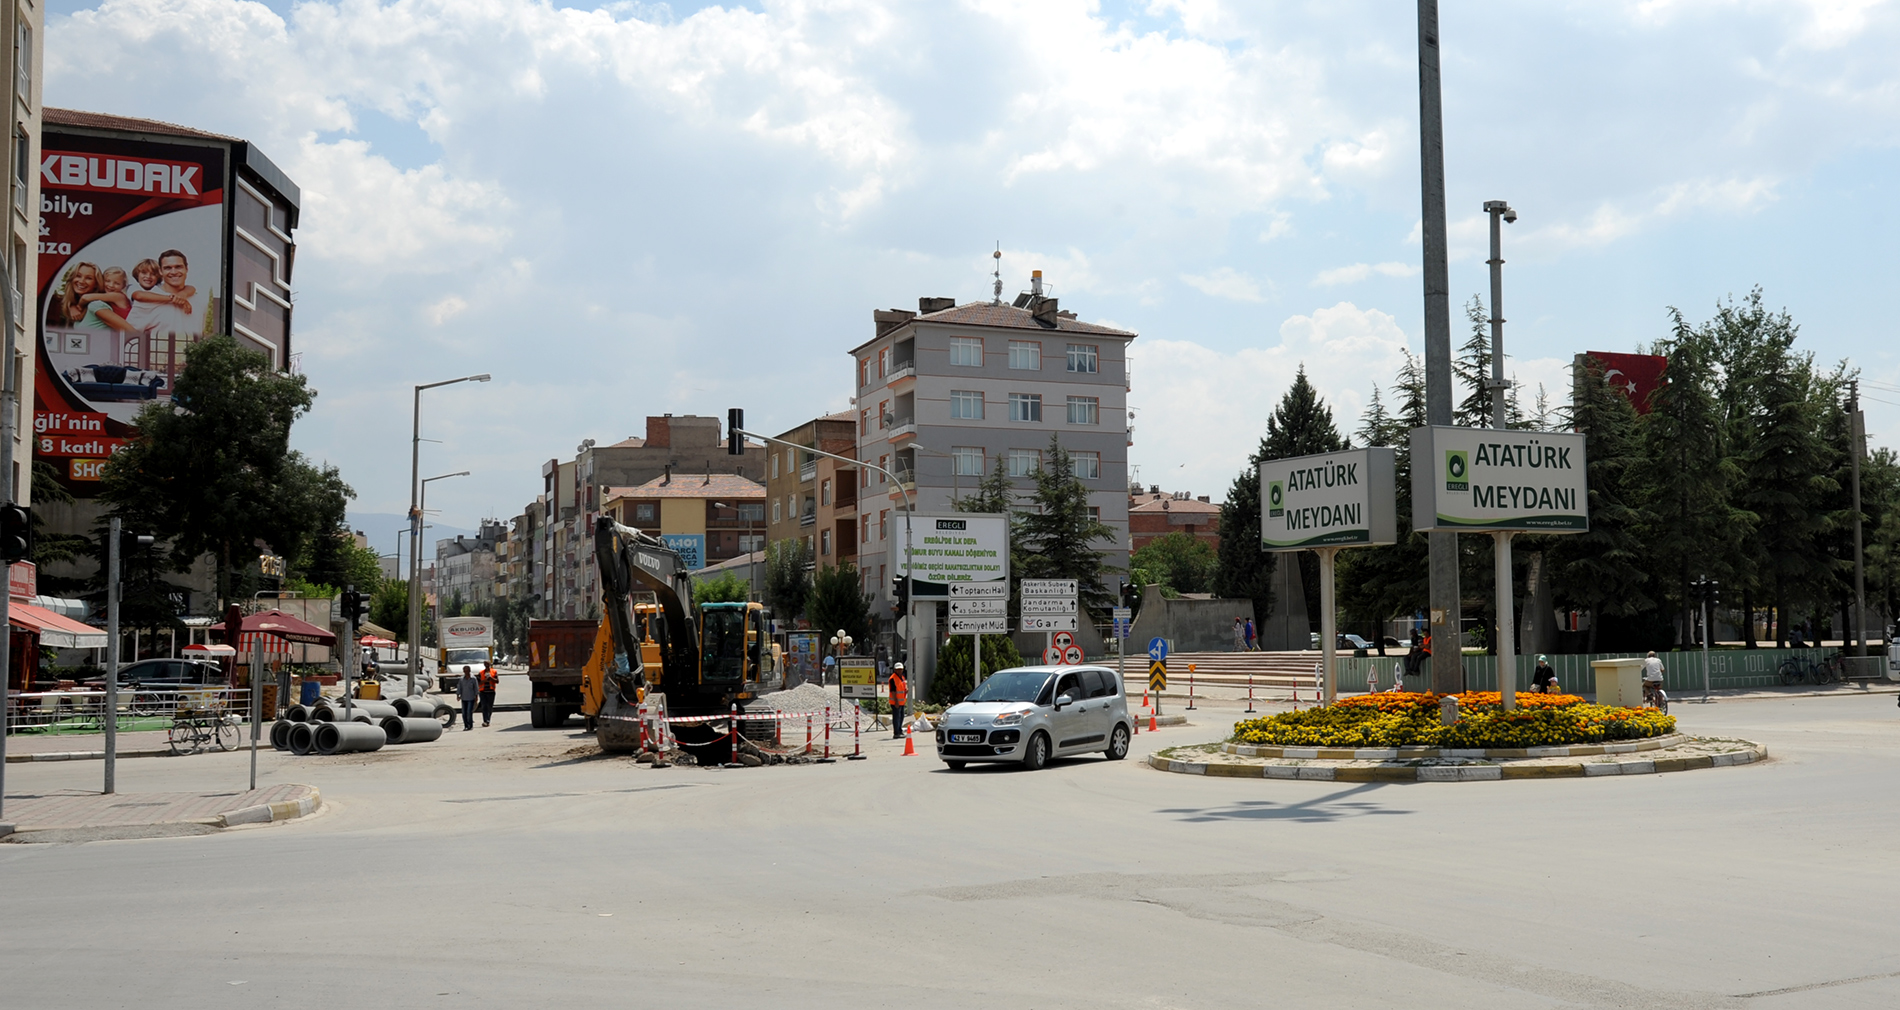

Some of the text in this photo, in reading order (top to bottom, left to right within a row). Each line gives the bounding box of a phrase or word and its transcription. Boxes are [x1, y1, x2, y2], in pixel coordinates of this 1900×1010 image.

[41, 439, 54, 452] 8
[61, 440, 104, 454] katlı
[1475, 440, 1572, 469] ATATÜRK
[1288, 460, 1358, 492] ATATÜRK
[1473, 485, 1576, 510] MEYDANI
[1286, 503, 1361, 531] MEYDANI
[937, 522, 965, 530] EREĞLİ
[904, 548, 927, 556] YĞMUR
[638, 552, 660, 570] VOLVO
[959, 620, 988, 632] Emniyet
[1036, 619, 1058, 628] Gar
[1706, 656, 1733, 673] 981
